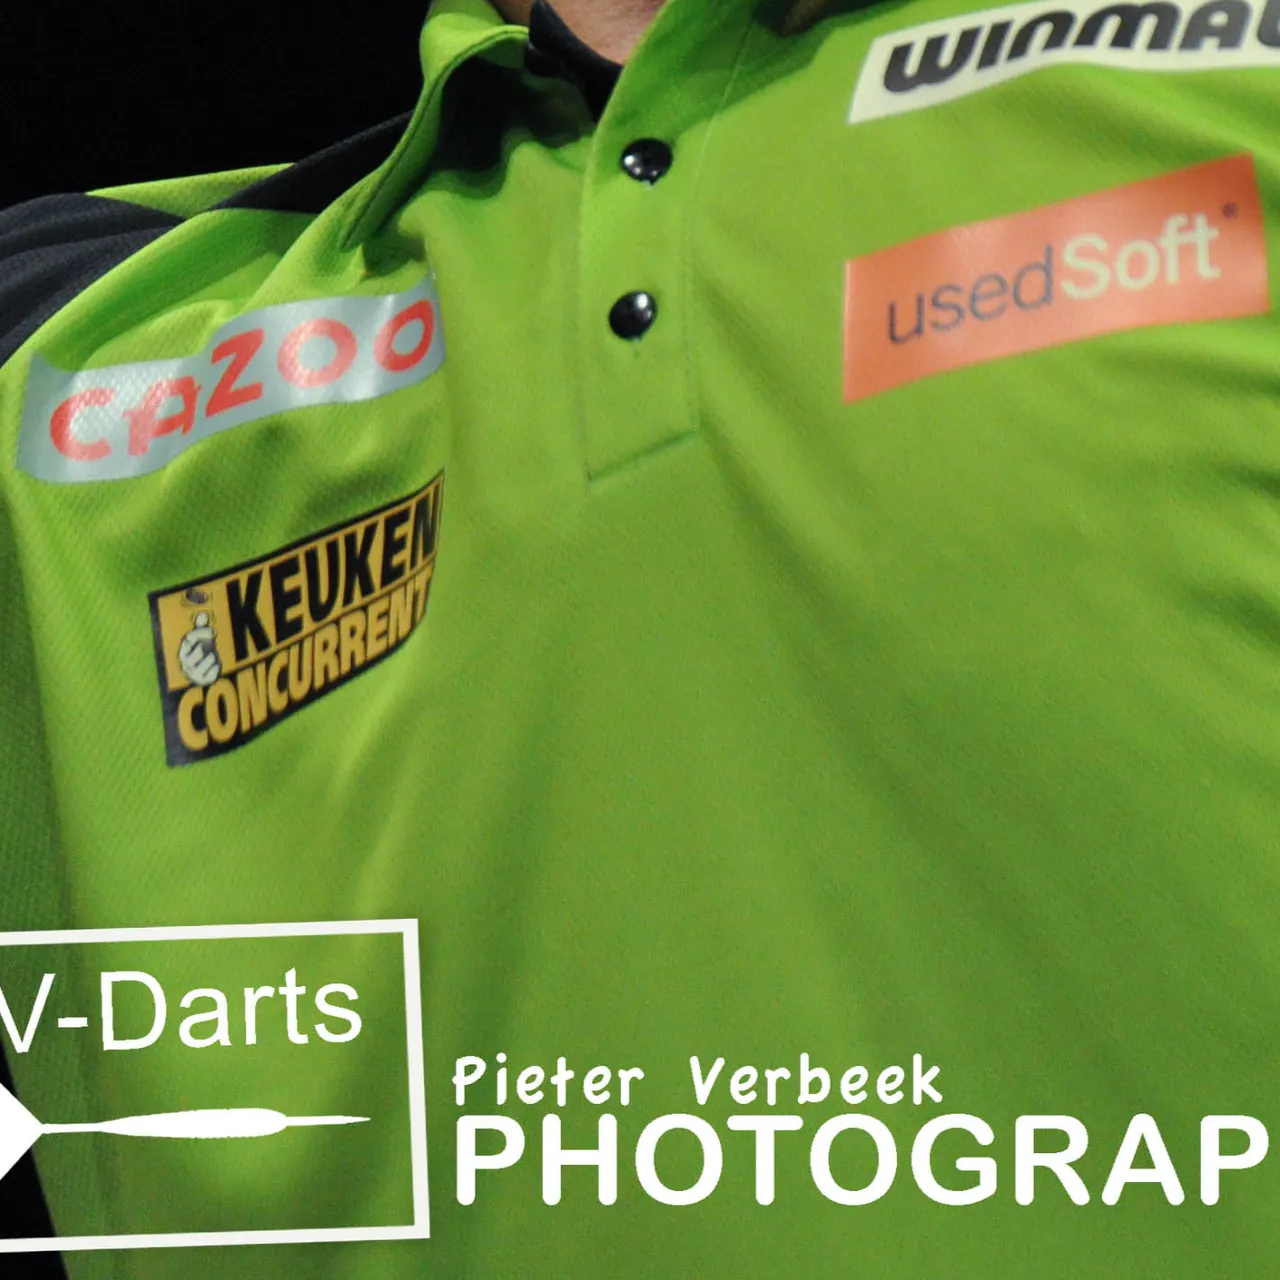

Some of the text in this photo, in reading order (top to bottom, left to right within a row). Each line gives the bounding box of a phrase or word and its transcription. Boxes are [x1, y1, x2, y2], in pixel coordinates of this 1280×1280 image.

[887, 214, 1220, 346] usedSoft
[48, 298, 436, 462] CAZOO
[176, 562, 433, 752] CONCURRENT
[225, 485, 441, 662] KEUKEN
